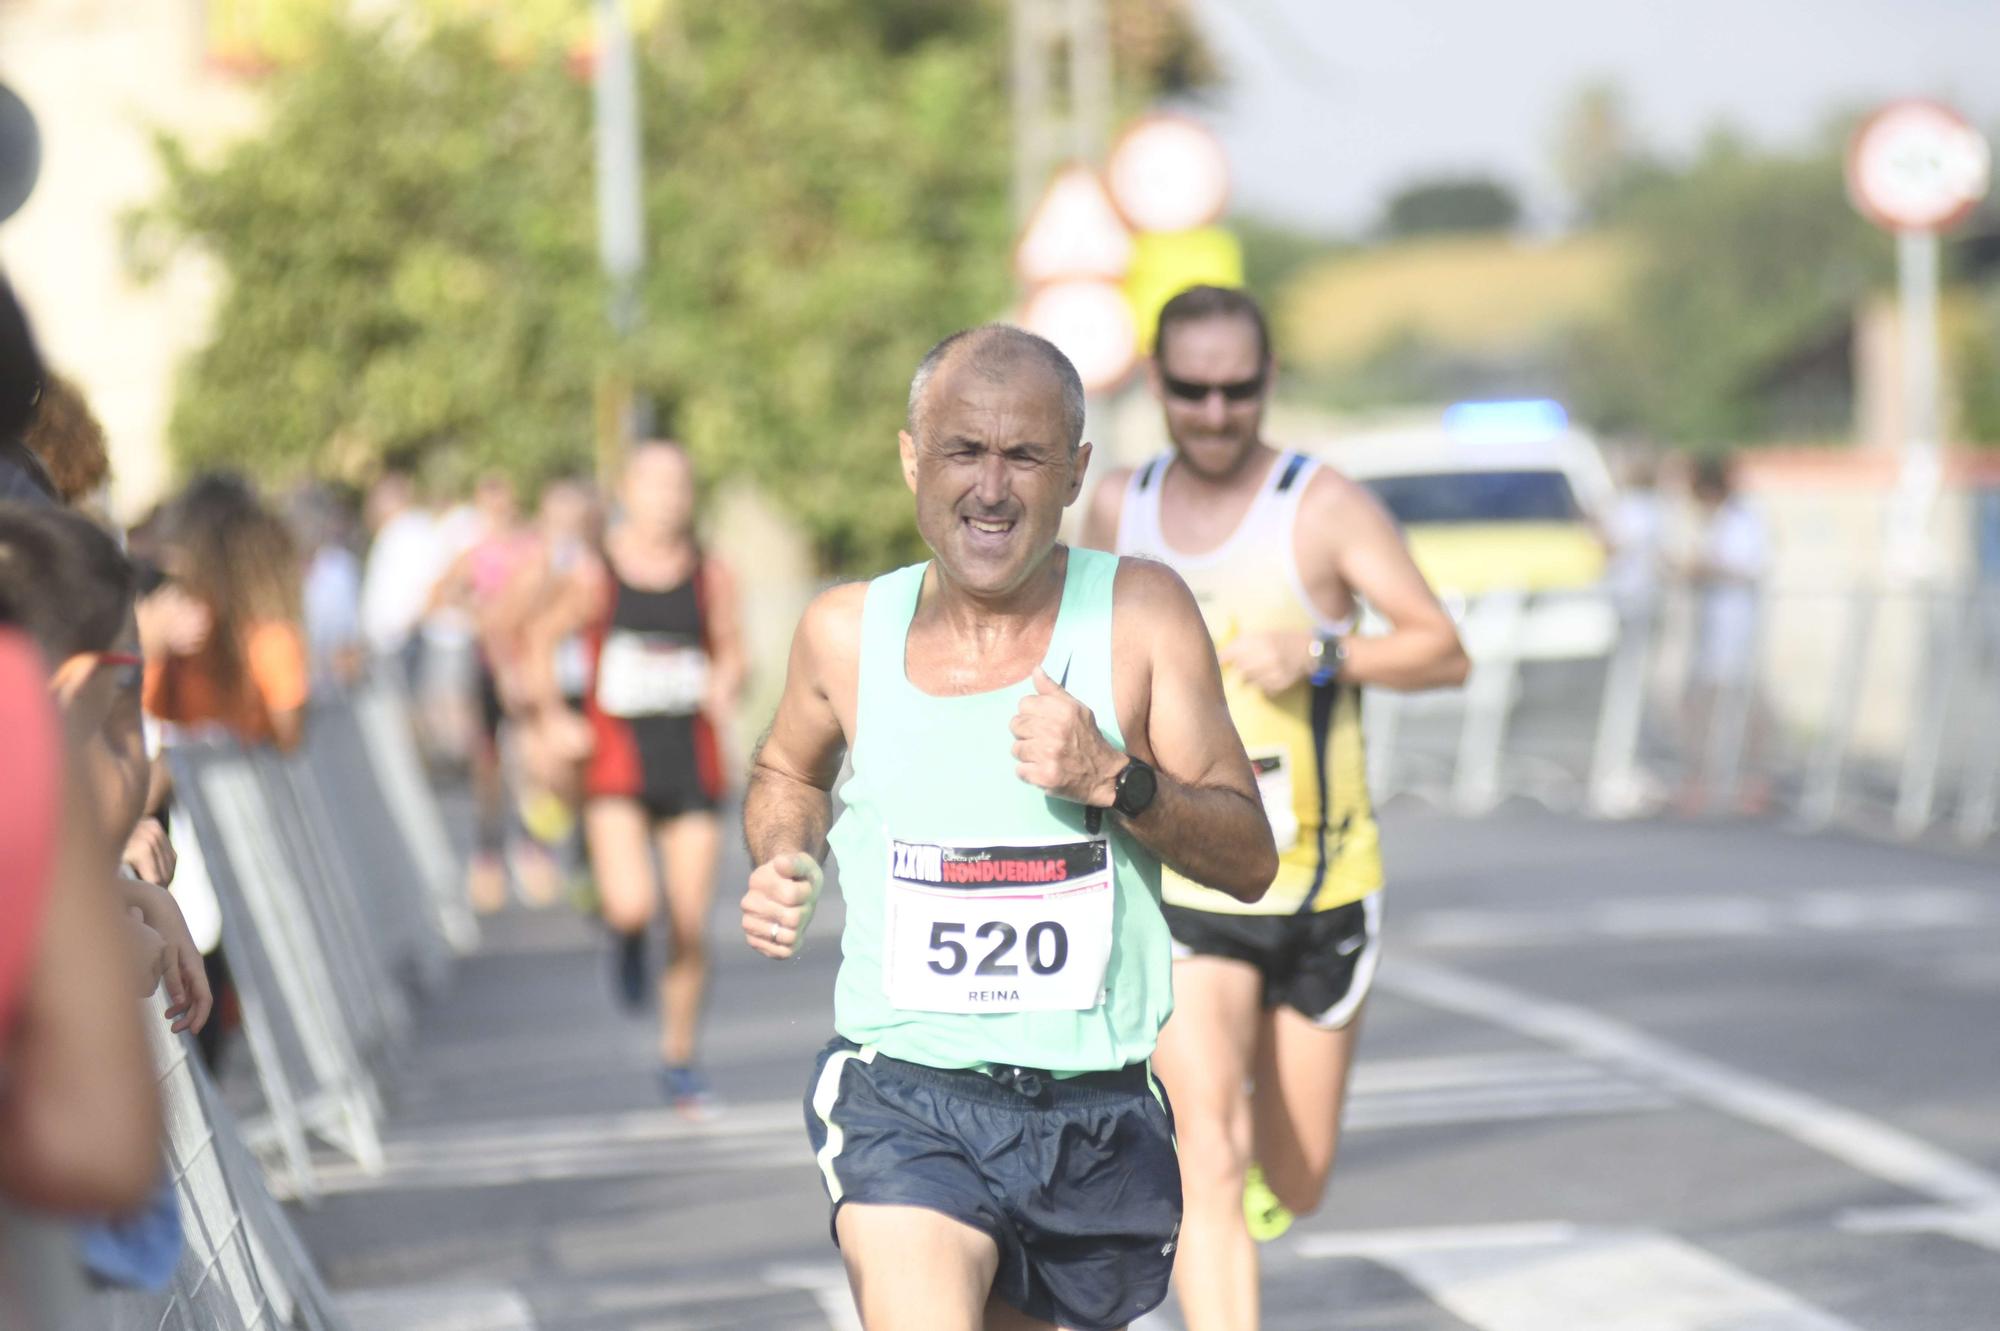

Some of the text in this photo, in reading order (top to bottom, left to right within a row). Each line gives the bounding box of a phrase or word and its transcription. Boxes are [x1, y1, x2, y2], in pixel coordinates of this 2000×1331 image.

[943, 858, 1067, 884] NONDUERMAS
[927, 920, 1068, 976] 520
[968, 989, 1020, 1001] REINA
